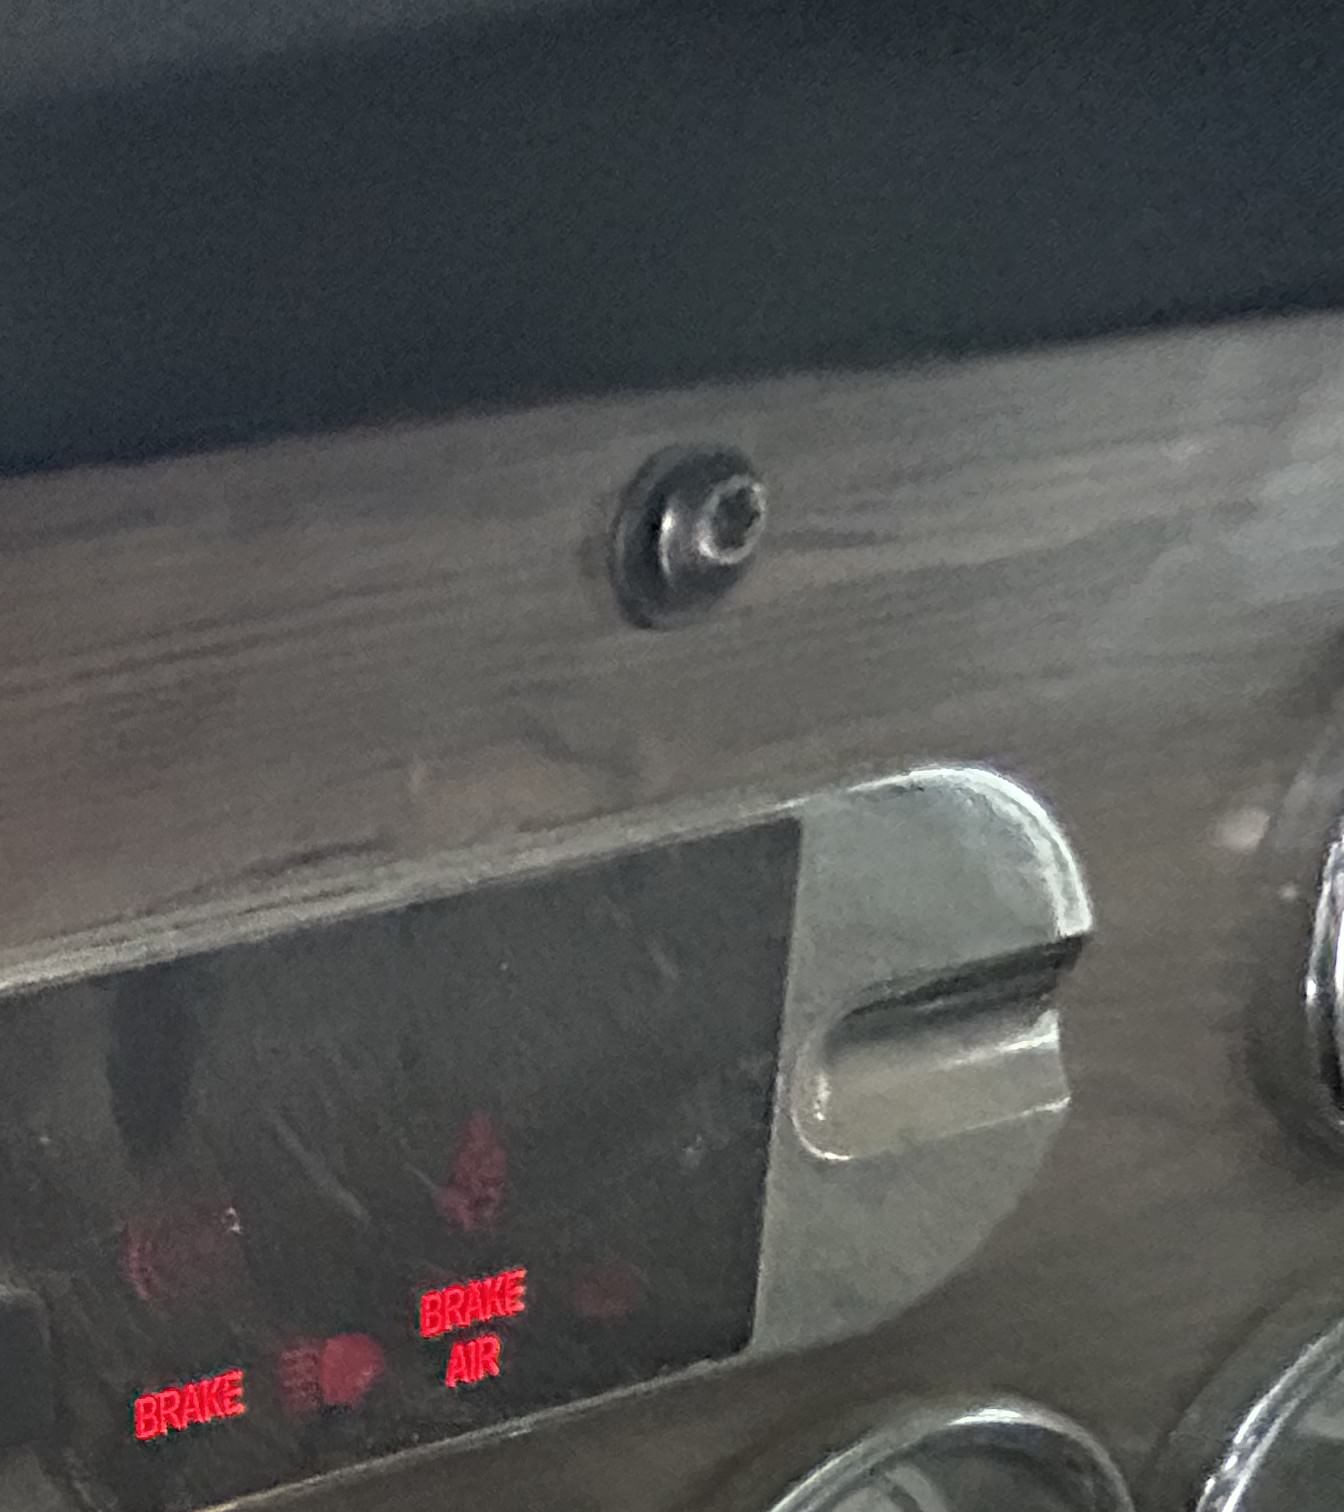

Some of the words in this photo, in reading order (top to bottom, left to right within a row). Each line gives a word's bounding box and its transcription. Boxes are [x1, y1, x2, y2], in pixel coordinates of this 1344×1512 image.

[419, 1266, 528, 1339] BRAKE
[445, 1333, 501, 1388] AIR
[133, 1367, 247, 1442] BRAKE
